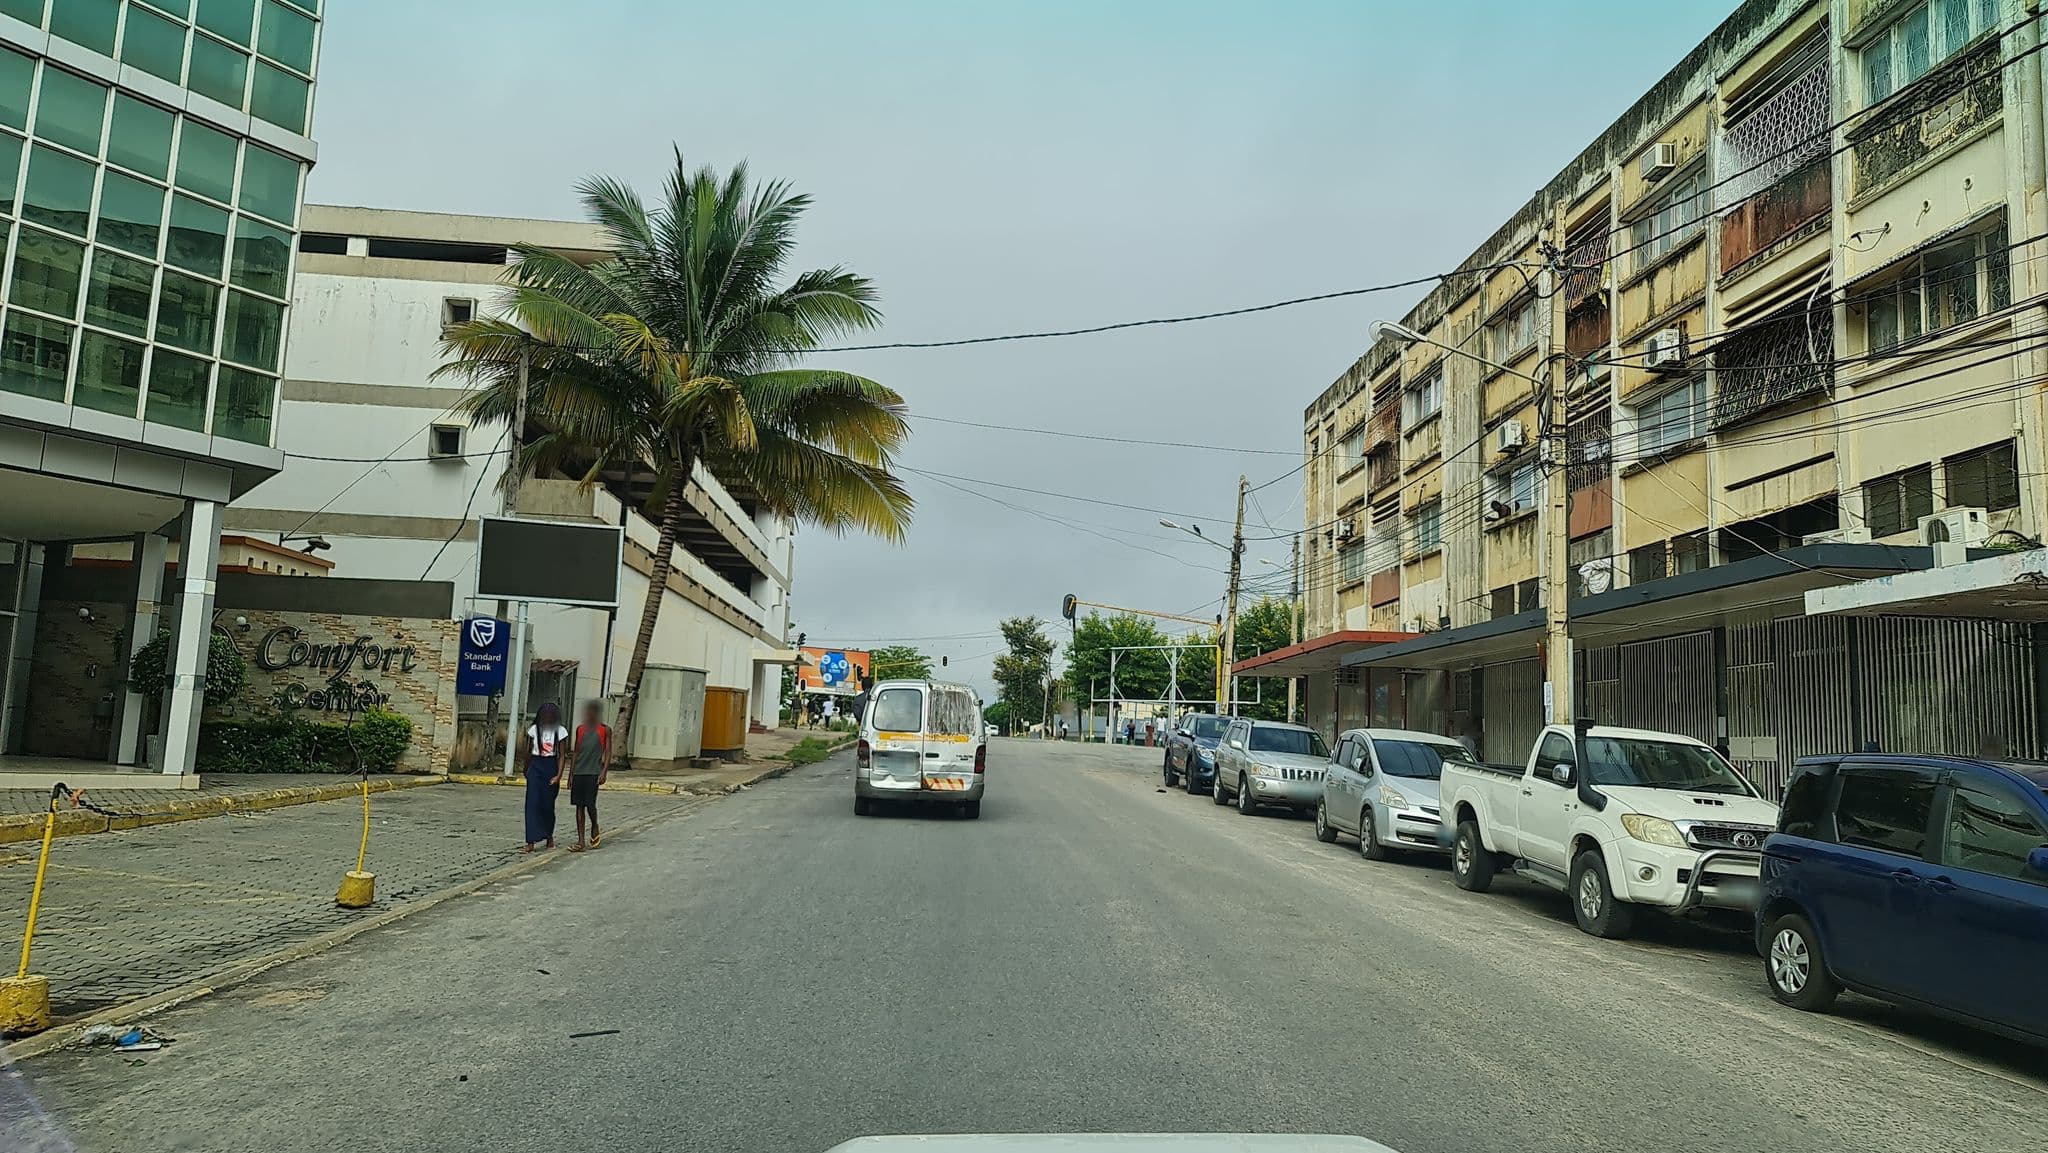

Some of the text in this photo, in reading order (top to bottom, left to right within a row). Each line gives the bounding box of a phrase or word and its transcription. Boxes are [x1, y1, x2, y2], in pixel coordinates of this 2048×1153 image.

[255, 625, 417, 682] Comfort
[463, 652, 501, 662] Standard
[471, 662, 492, 671] Bank
[286, 682, 389, 710] Center
